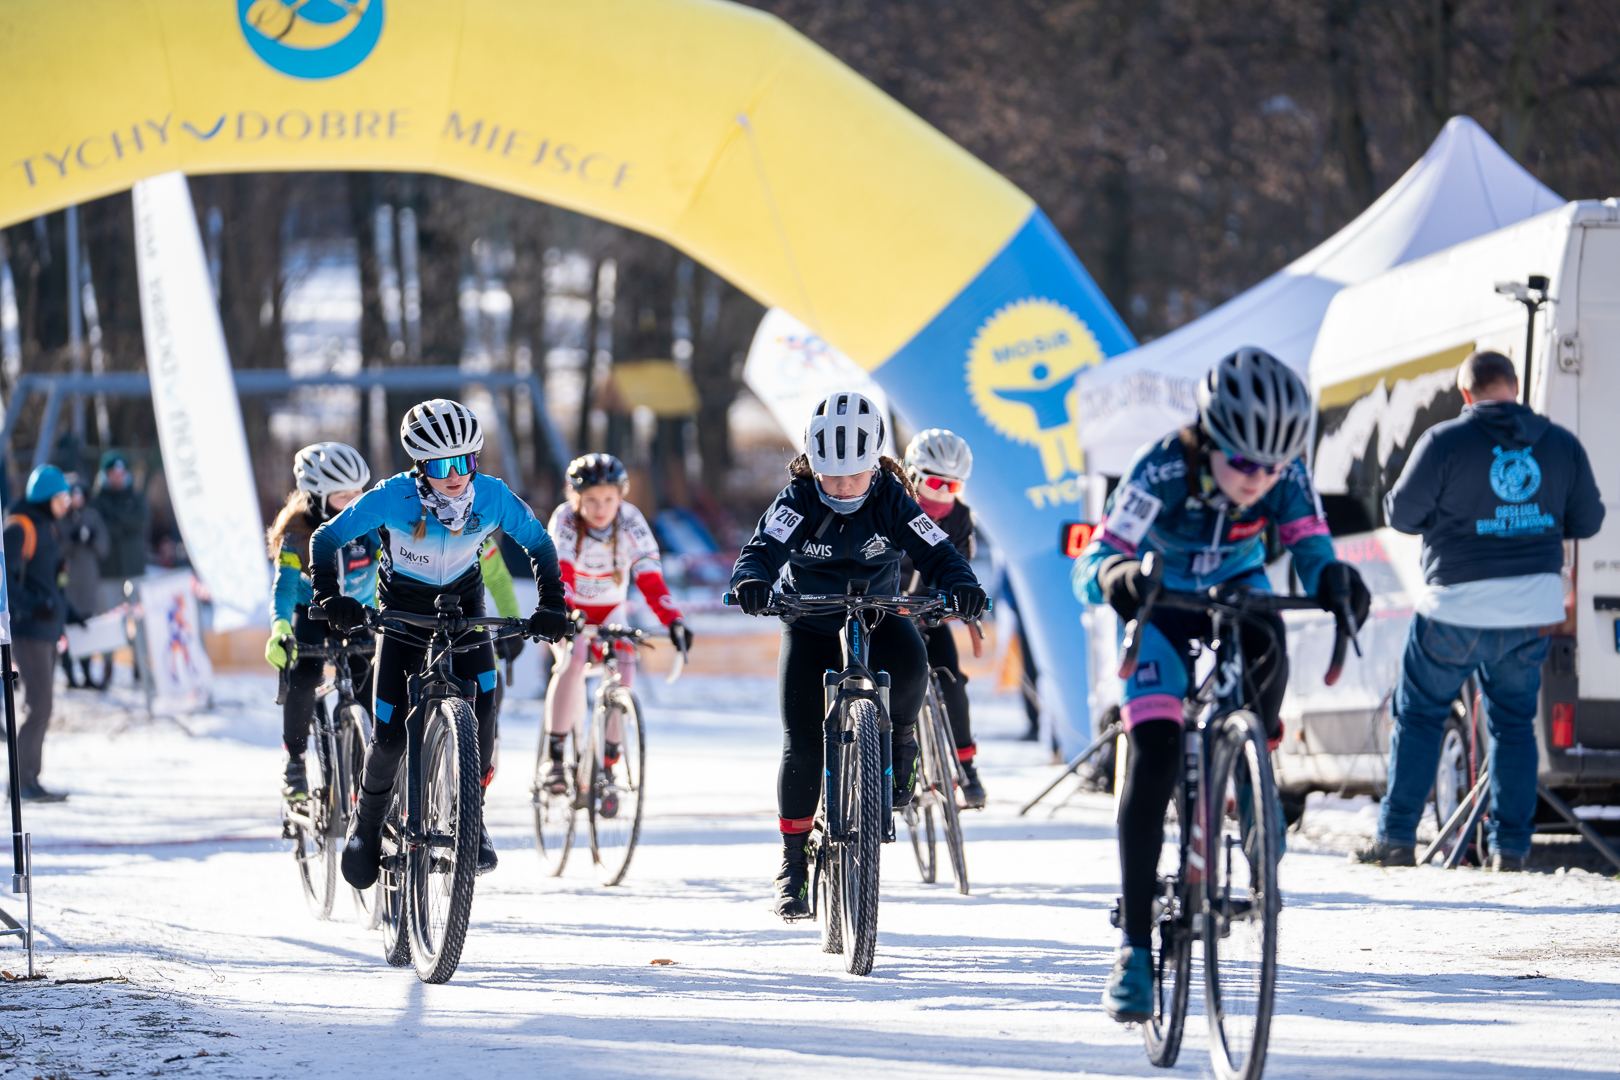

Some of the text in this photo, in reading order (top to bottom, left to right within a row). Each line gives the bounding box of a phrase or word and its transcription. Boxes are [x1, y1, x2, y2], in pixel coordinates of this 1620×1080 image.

[12, 108, 637, 192] TYCHY DOBRE MIEJSCE
[775, 509, 799, 528] 216
[913, 516, 934, 535] 216
[400, 546, 430, 564] DAVIS
